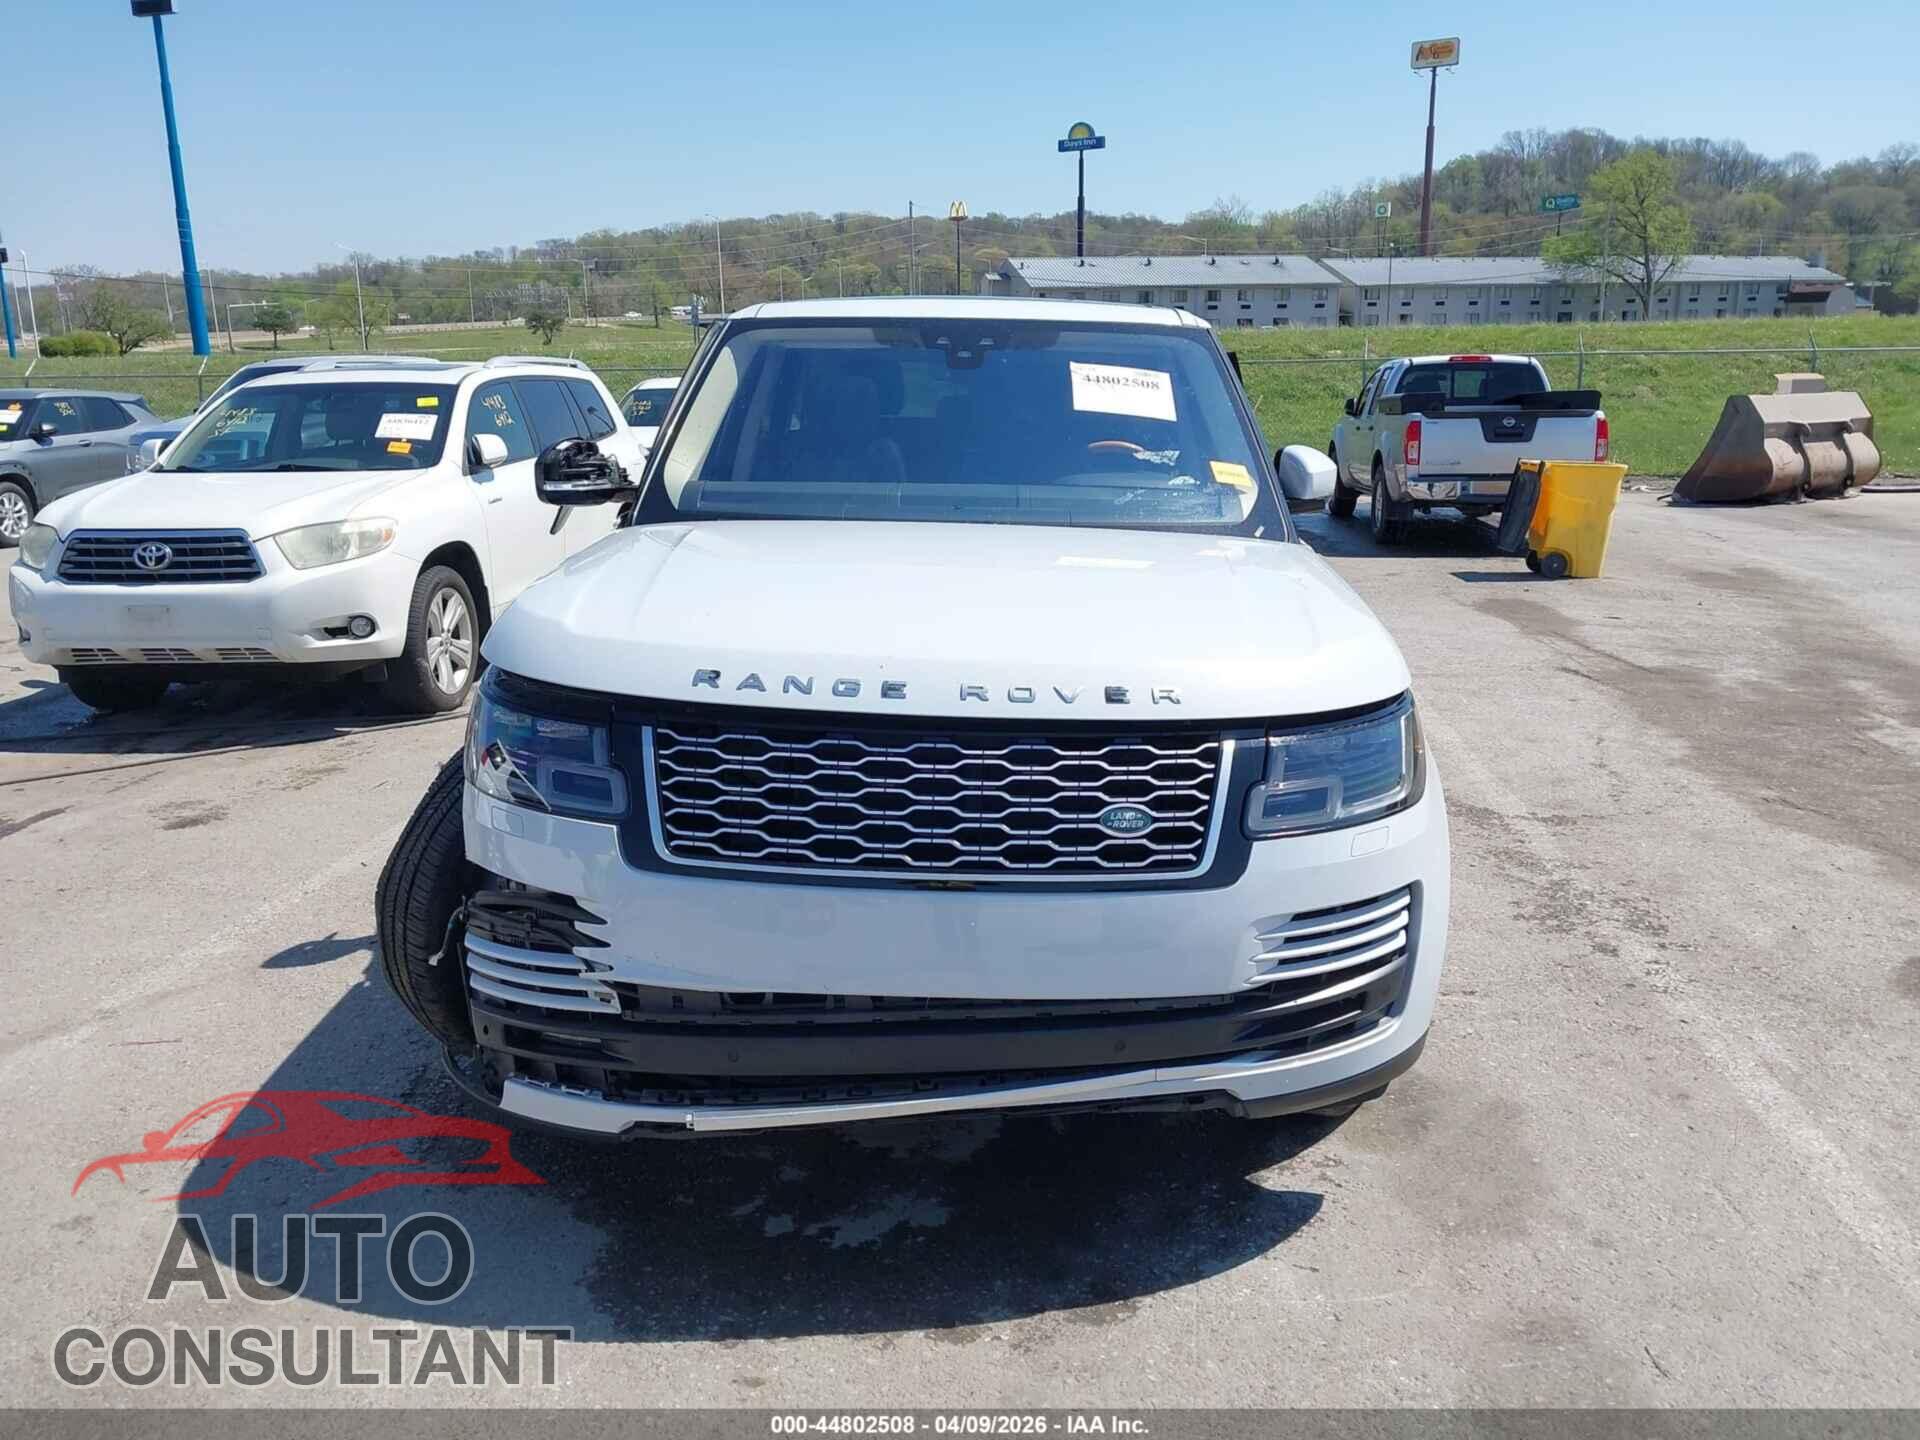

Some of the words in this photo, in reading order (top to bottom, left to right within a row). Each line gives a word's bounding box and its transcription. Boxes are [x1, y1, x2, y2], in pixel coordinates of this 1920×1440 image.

[1082, 373, 1160, 391] 44802508
[692, 668, 909, 700] RANGE
[960, 683, 1183, 706] ROVER
[1110, 811, 1136, 820] LAND
[1112, 820, 1144, 829] ROVER
